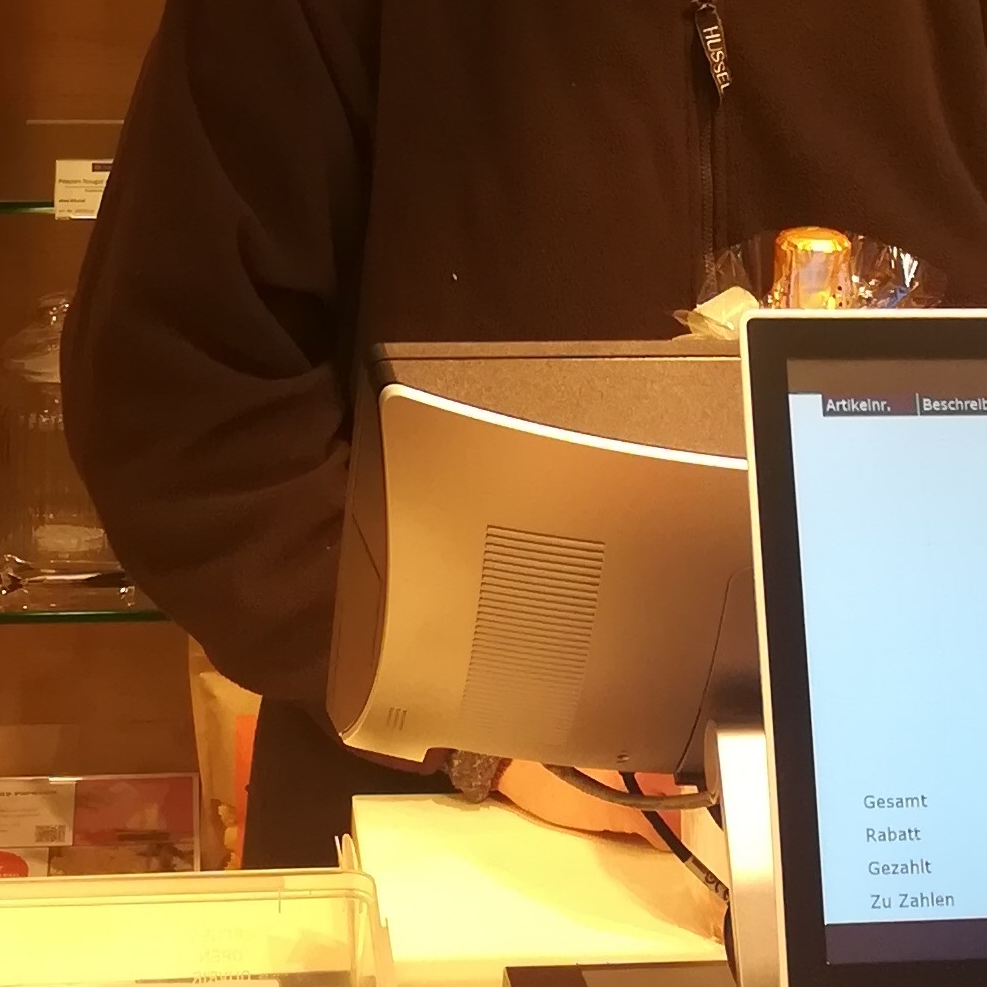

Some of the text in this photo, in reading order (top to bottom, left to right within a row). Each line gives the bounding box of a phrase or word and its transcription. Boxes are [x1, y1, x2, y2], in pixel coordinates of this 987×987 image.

[702, 25, 733, 94] HUSSEL
[825, 398, 892, 413] Artikelnr.
[863, 794, 928, 809] Gesamt
[866, 827, 921, 842] Rabatt
[868, 859, 932, 876] Gezahlt
[870, 892, 955, 909] Zu Zahlen
